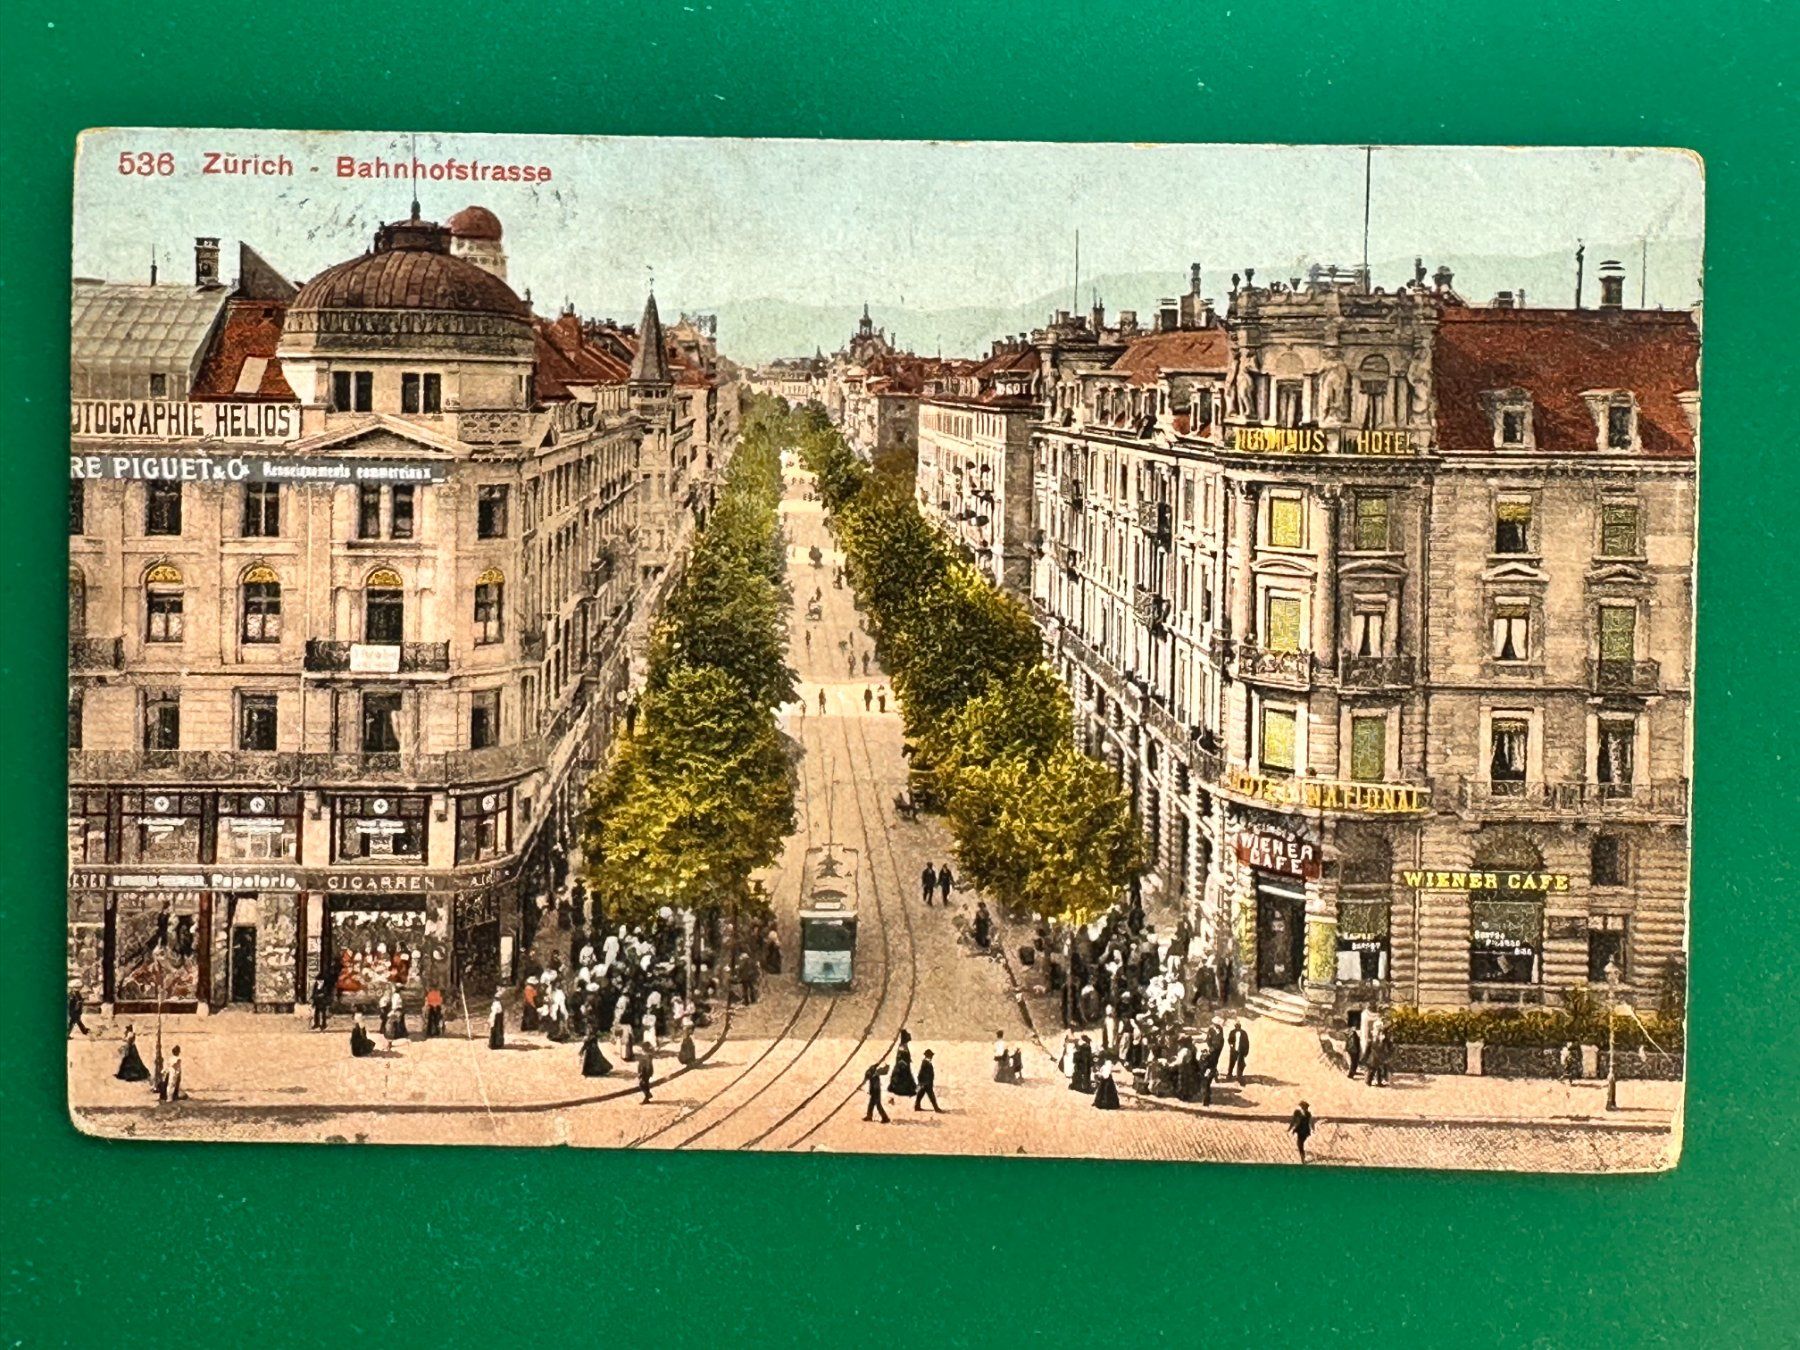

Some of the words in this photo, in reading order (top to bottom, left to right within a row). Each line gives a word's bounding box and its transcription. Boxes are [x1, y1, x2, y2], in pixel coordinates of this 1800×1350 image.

[118, 151, 176, 176] 536
[202, 151, 294, 177] Zürich
[336, 155, 553, 183] Bahnhofstrasse
[215, 404, 290, 437] HELIOS
[1356, 430, 1415, 454] HOTEL
[1239, 832, 1313, 861] WIENER
[1403, 871, 1498, 889] WIENER
